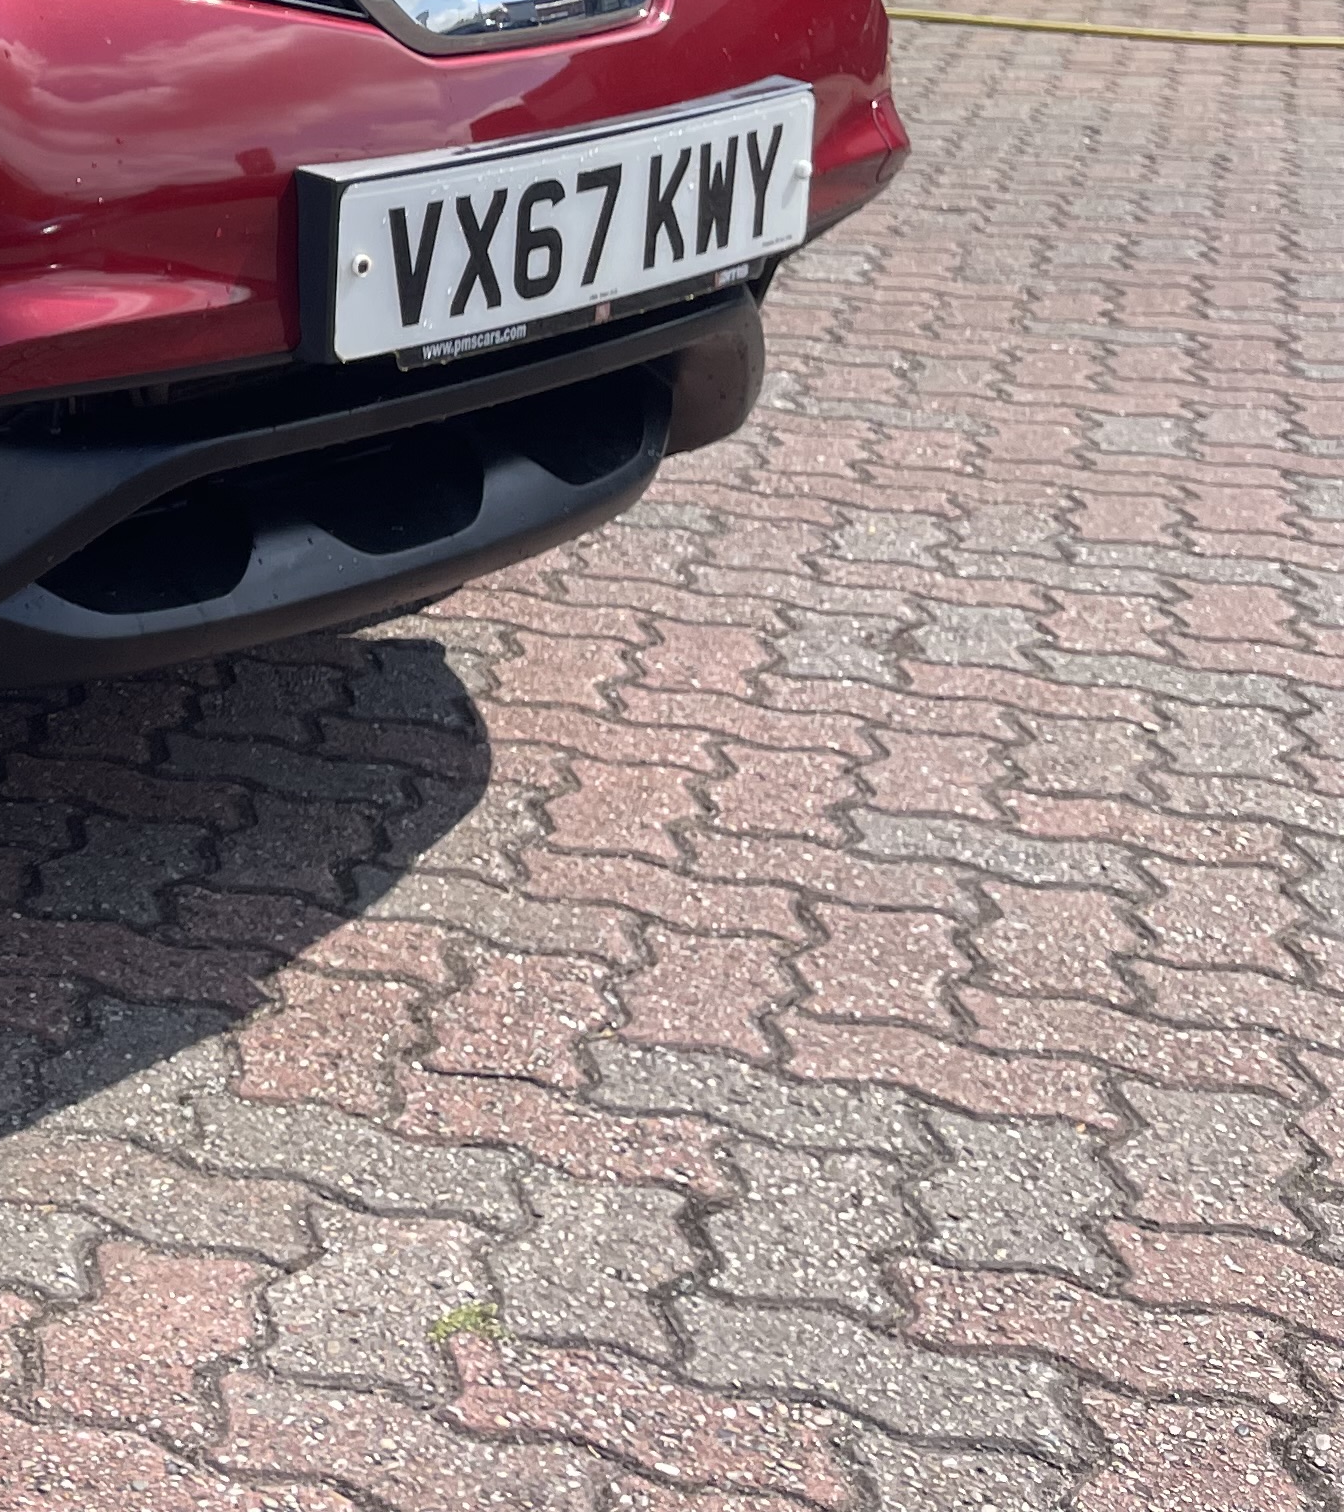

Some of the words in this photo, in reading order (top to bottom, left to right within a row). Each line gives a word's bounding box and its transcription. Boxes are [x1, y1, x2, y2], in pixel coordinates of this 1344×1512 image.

[387, 163, 624, 328] VX67
[642, 123, 784, 271] KWY
[421, 321, 528, 361] www.pmscars.com
